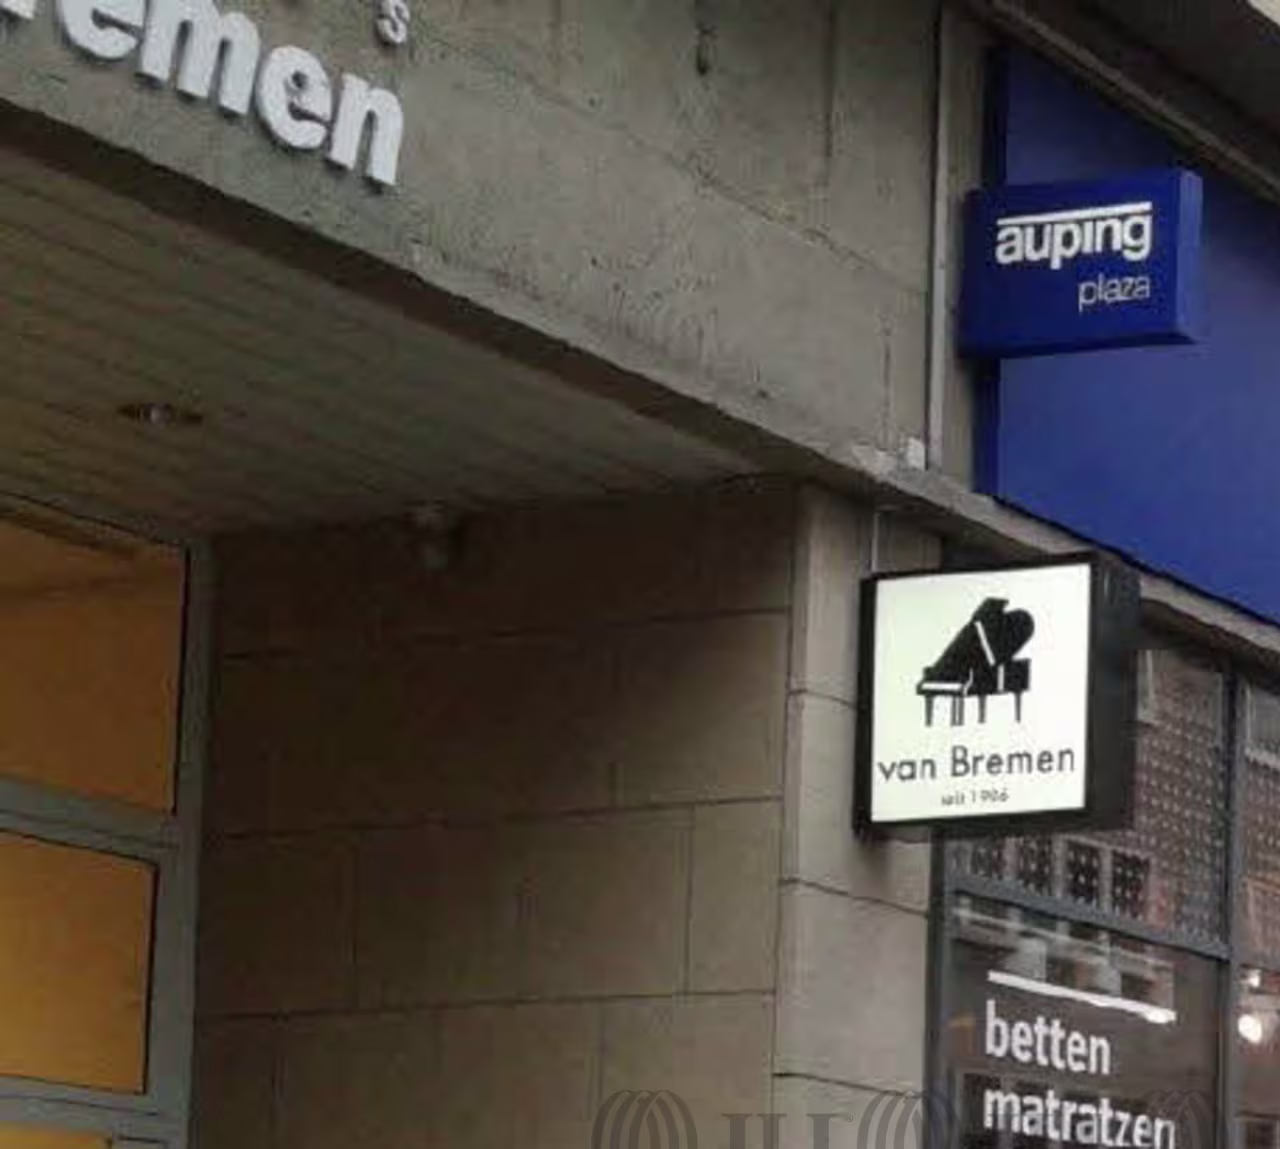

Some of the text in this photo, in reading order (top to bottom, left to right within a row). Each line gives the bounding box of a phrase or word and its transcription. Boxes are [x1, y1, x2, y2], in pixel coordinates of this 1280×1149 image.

[0, 0, 404, 187] emen
[994, 213, 1152, 270] auping
[1077, 273, 1151, 313] plaza
[877, 744, 1076, 782] van Bremen
[984, 999, 1112, 1076] betten
